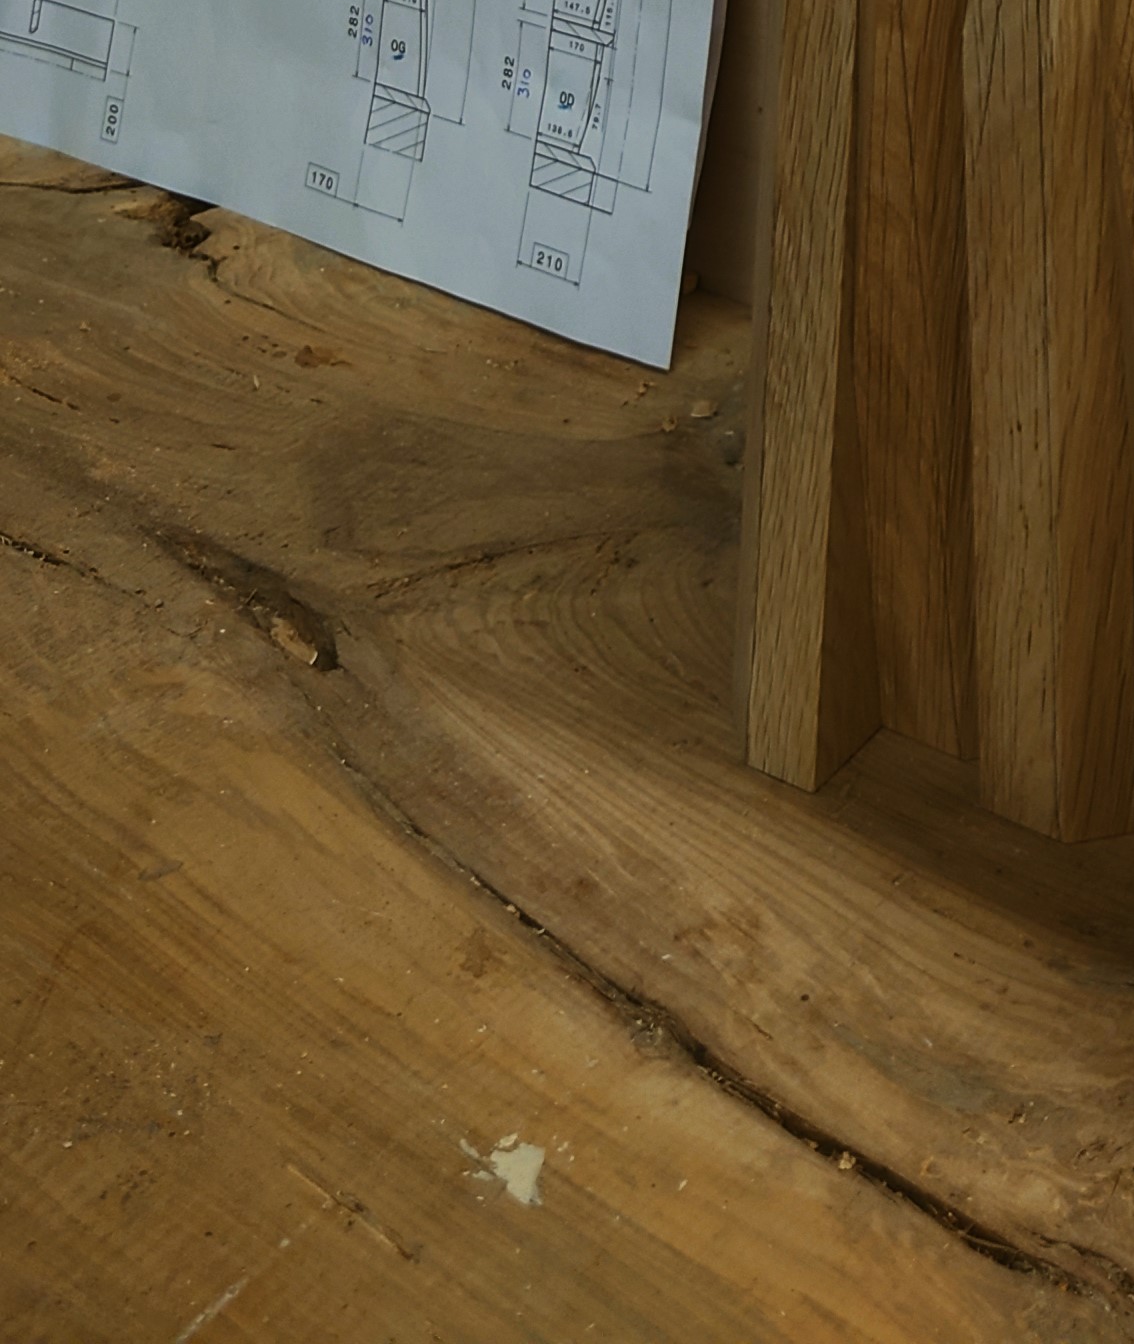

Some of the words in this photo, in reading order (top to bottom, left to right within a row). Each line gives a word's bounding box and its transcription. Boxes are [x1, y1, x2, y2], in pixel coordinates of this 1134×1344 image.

[348, 5, 360, 39] 282
[362, 14, 374, 47] 310
[569, 41, 585, 52] 170
[501, 56, 515, 90] 282
[517, 69, 532, 98] 310
[106, 104, 119, 136] 200
[311, 170, 335, 191] 170
[536, 250, 564, 272] 210
